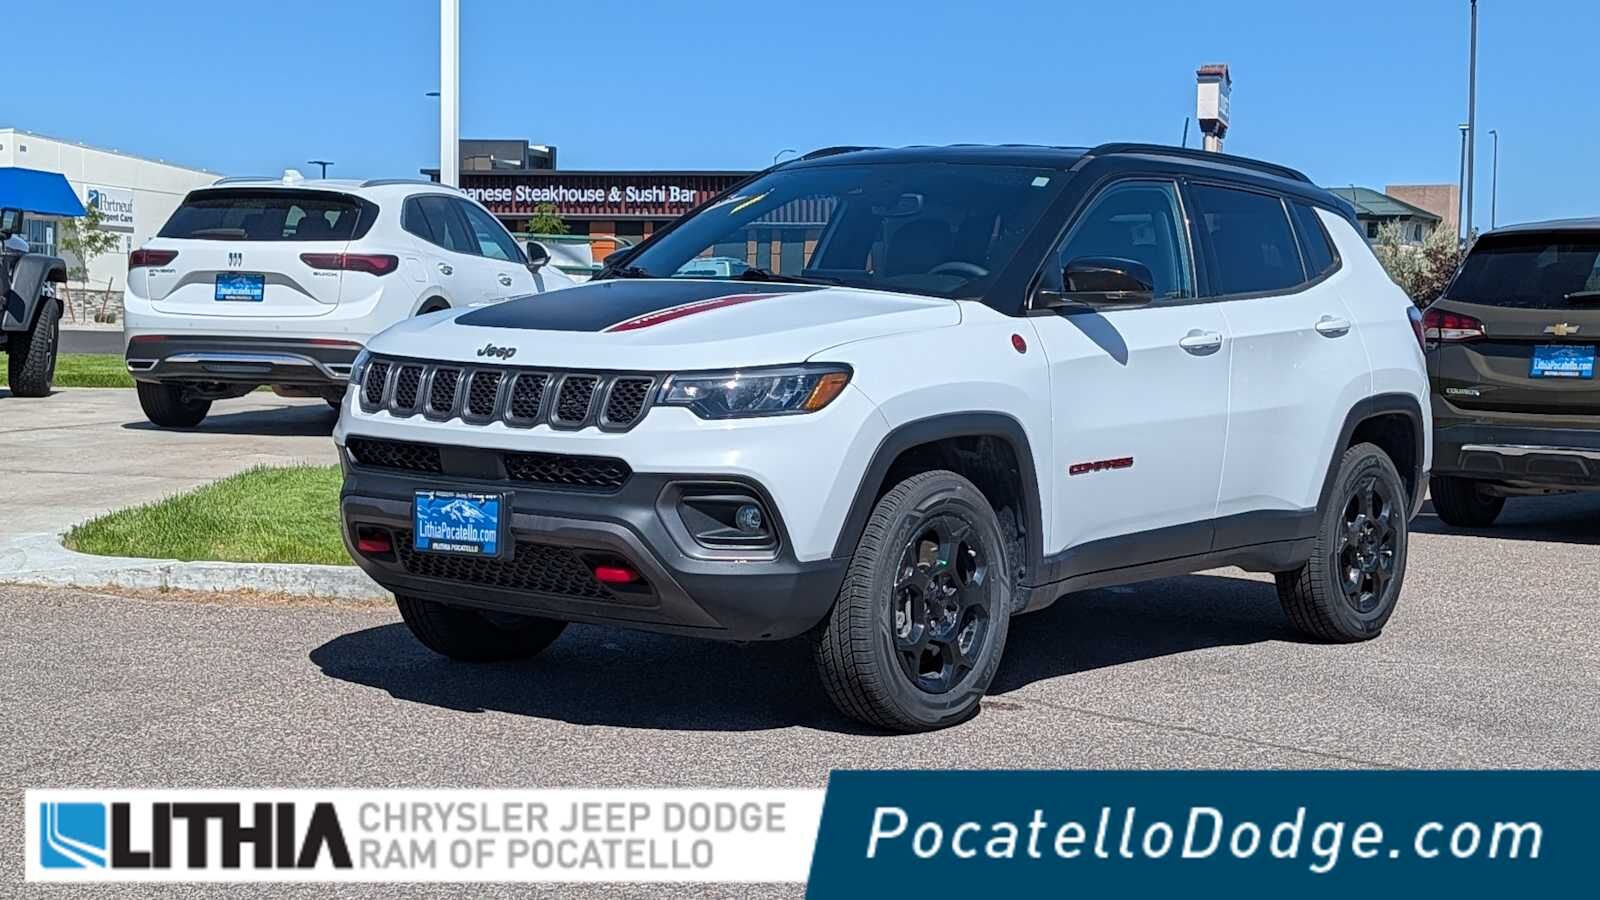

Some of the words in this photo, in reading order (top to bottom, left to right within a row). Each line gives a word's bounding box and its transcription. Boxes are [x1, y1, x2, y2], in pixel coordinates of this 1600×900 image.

[100, 192, 133, 213] Portneuf
[515, 185, 605, 202] Steakhouse
[608, 186, 621, 202] &
[625, 185, 666, 202] Sushi
[669, 186, 697, 202] Bar
[120, 214, 133, 222] Care
[477, 343, 517, 360] Jeep
[1069, 457, 1133, 476] COMPASS
[419, 519, 497, 542] LithiaPocatello.com
